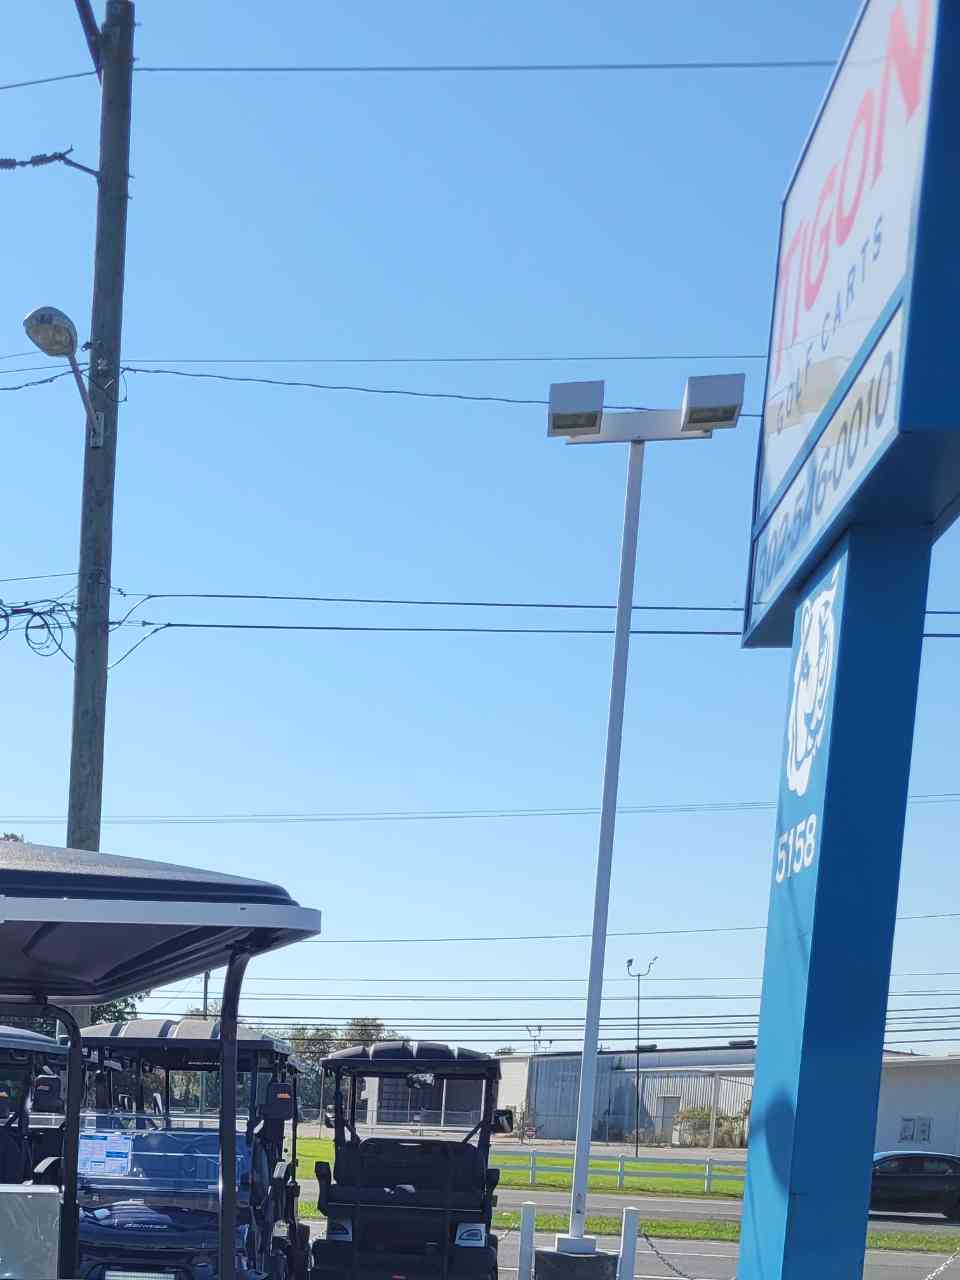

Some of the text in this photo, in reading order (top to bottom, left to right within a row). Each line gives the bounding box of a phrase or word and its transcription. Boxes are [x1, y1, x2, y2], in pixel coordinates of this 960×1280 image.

[774, 0, 931, 381] TIGON
[777, 215, 883, 435] GOLF CARTS
[776, 814, 817, 882] 5158
